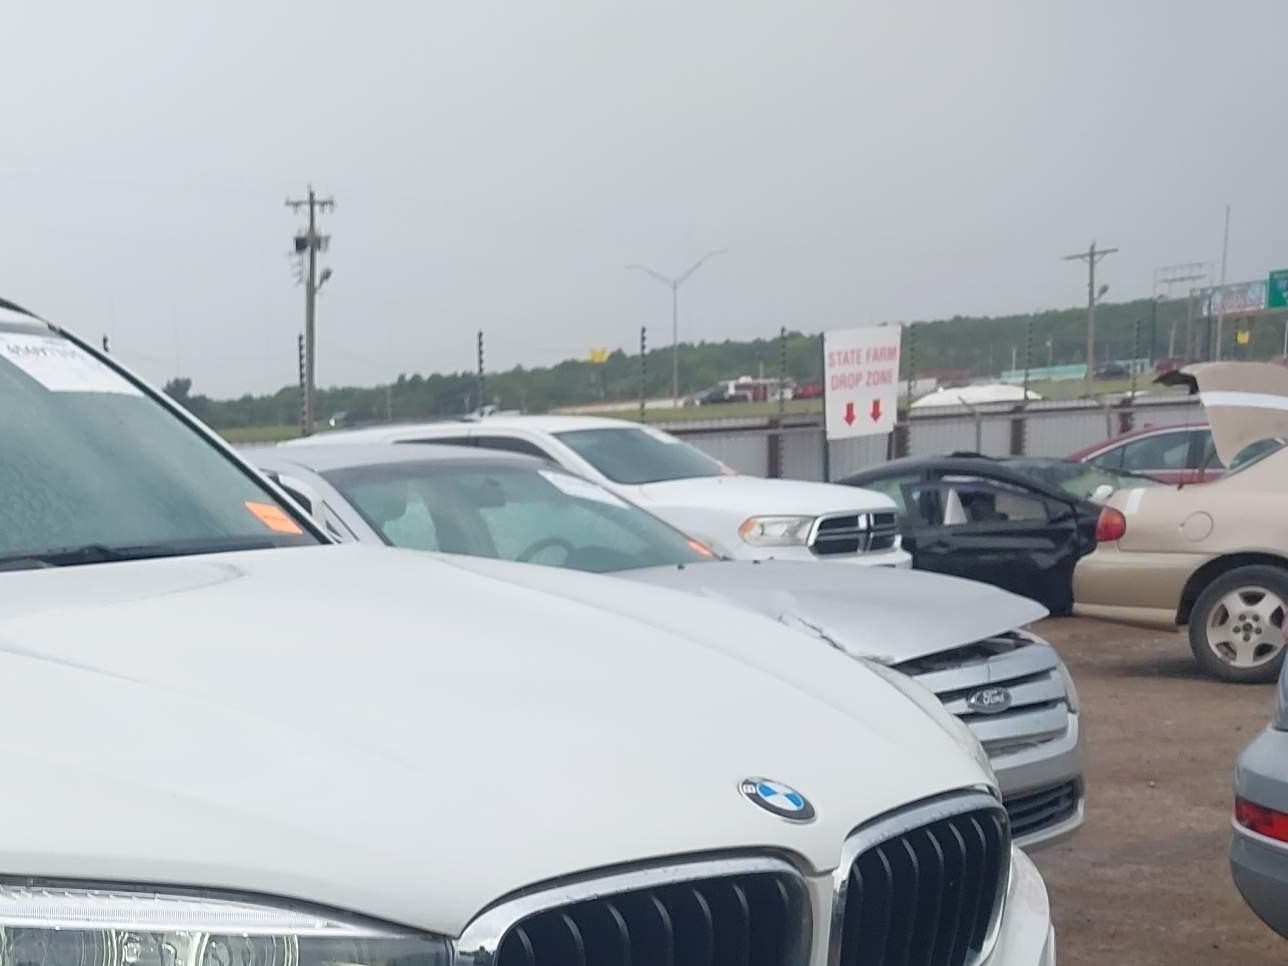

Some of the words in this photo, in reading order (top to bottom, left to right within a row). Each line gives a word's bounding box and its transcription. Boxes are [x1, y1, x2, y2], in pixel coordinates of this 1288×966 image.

[828, 349, 863, 368] STATE
[866, 346, 897, 364] FARM
[831, 372, 864, 391] DROP
[866, 369, 893, 387] ZONE
